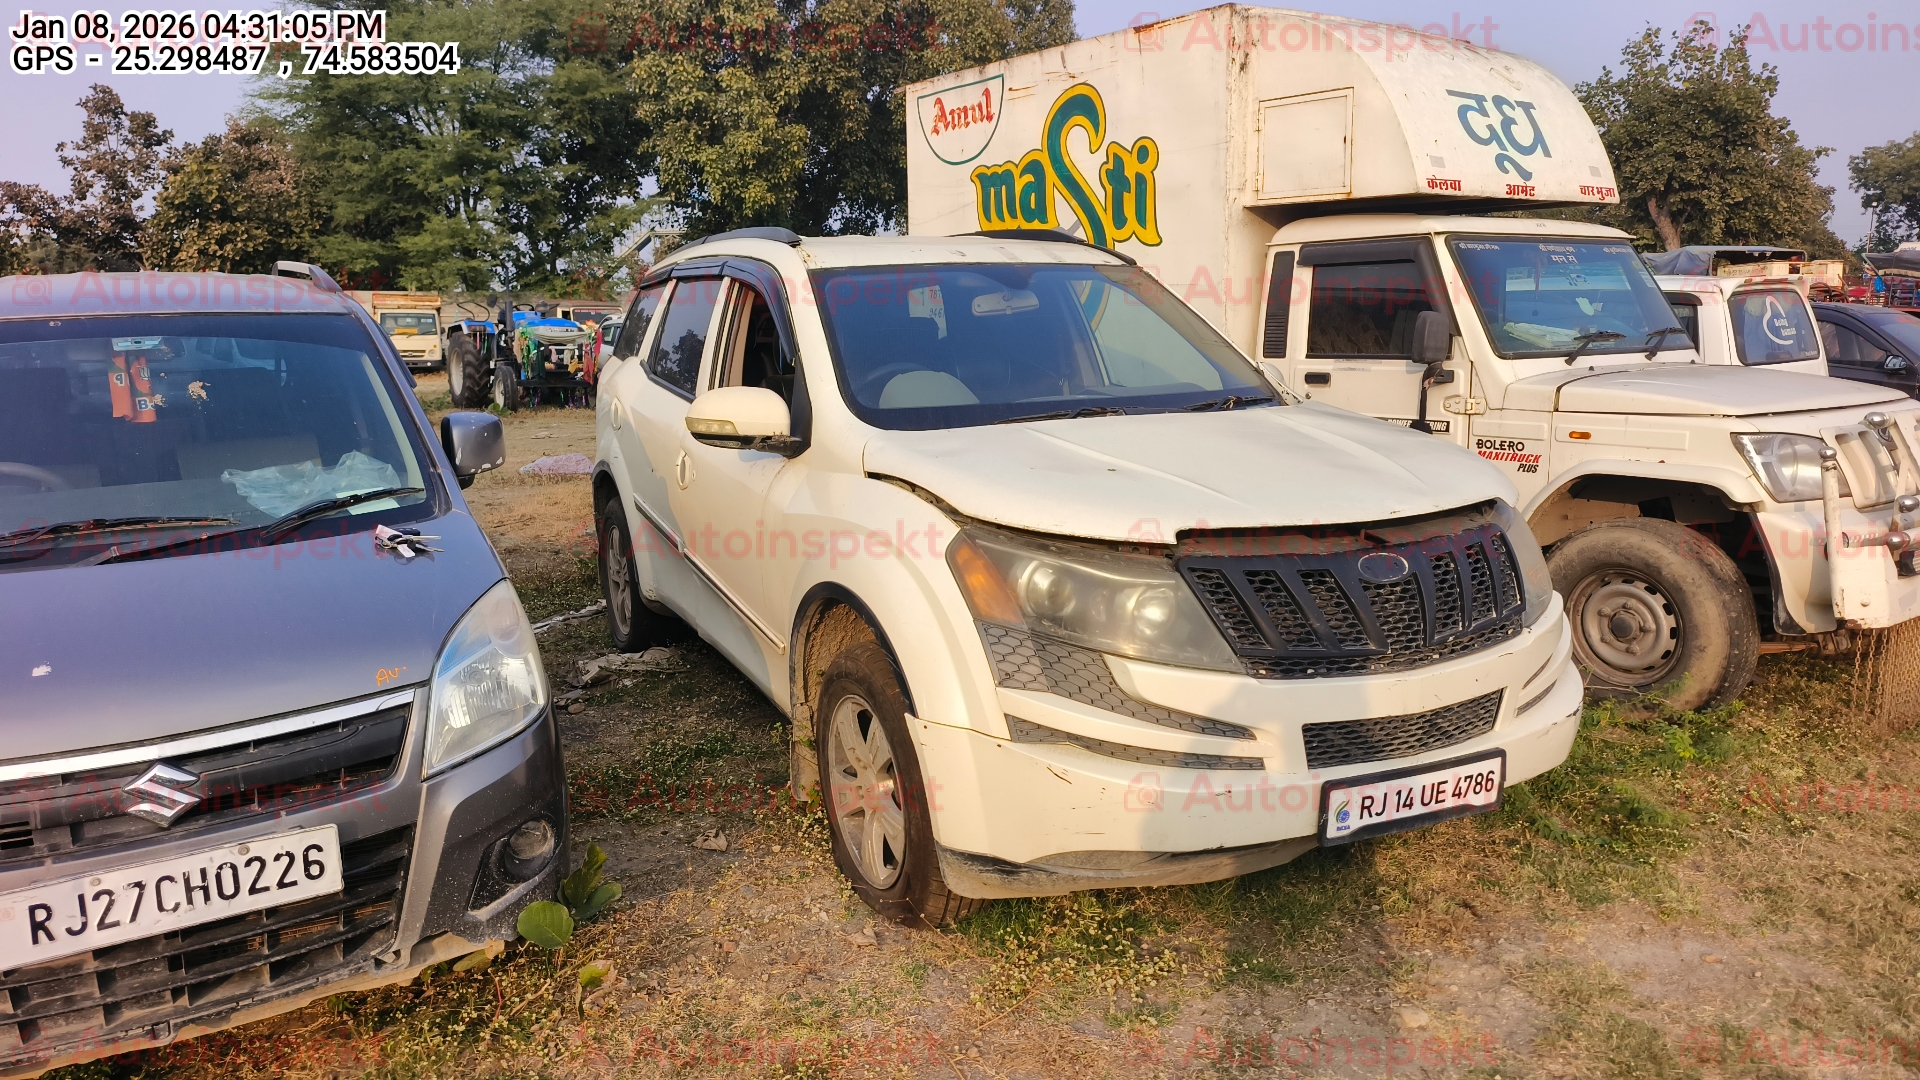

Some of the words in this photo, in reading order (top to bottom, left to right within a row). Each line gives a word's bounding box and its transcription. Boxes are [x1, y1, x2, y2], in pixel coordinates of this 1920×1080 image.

[930, 86, 997, 138] Amul
[1445, 88, 1552, 182] दूध
[1476, 438, 1525, 453] BOLERO
[1478, 450, 1542, 464] MAXITRUCK
[1517, 463, 1539, 474] PLUS
[1359, 792, 1388, 820] RJ
[1395, 787, 1415, 813] 14
[1420, 780, 1449, 807] UE
[1451, 770, 1496, 801] 4786
[27, 842, 327, 946] RJ27CH0226
